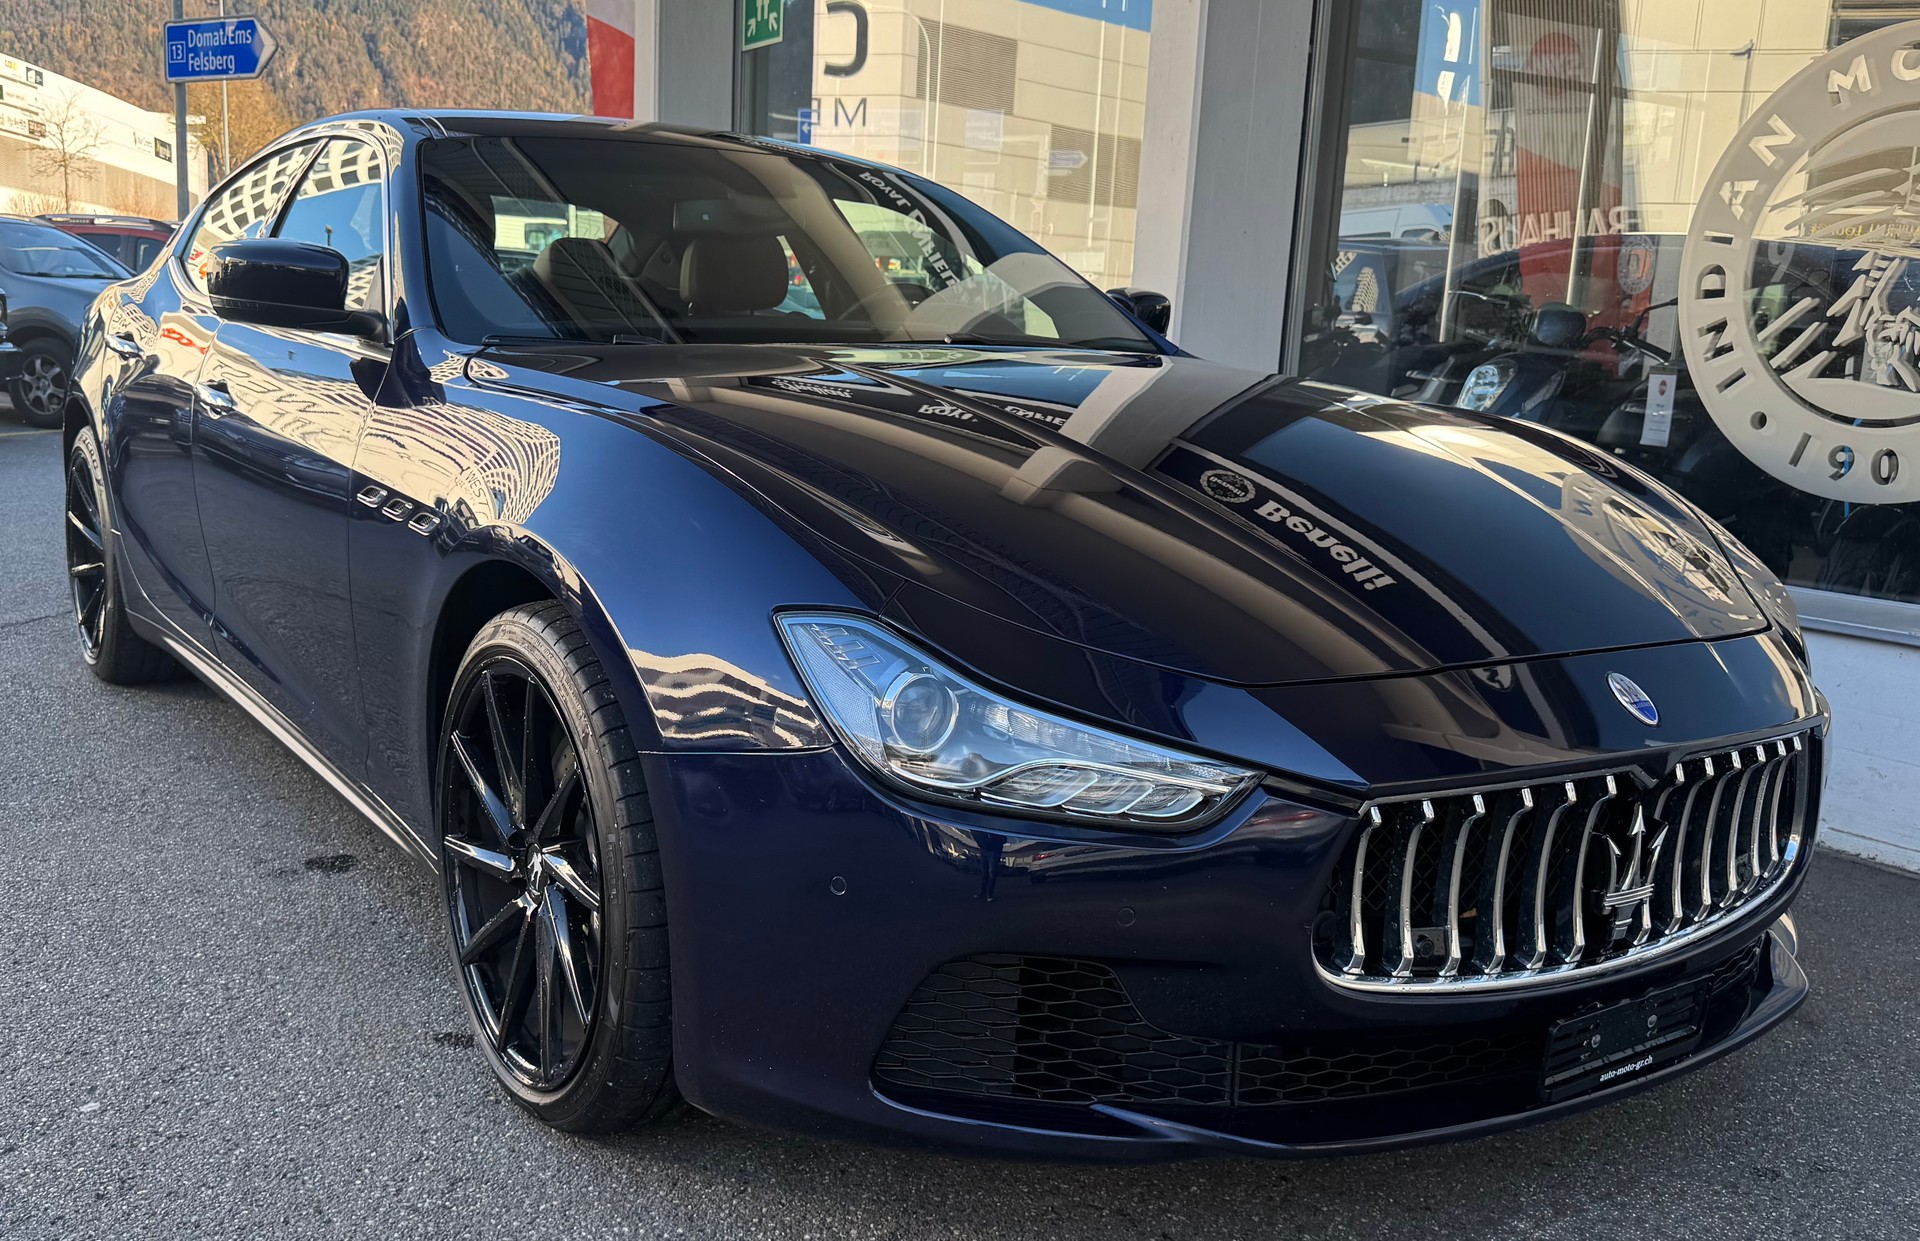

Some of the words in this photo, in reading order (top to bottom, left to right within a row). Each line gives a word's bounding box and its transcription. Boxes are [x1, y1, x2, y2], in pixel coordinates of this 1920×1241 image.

[187, 26, 252, 48] Domat/Ems
[171, 45, 183, 60] 13
[188, 50, 236, 74] Felsberg
[1697, 113, 1797, 394] INDIAN
[1599, 1055, 1653, 1082] auto-moto-gr.ch
